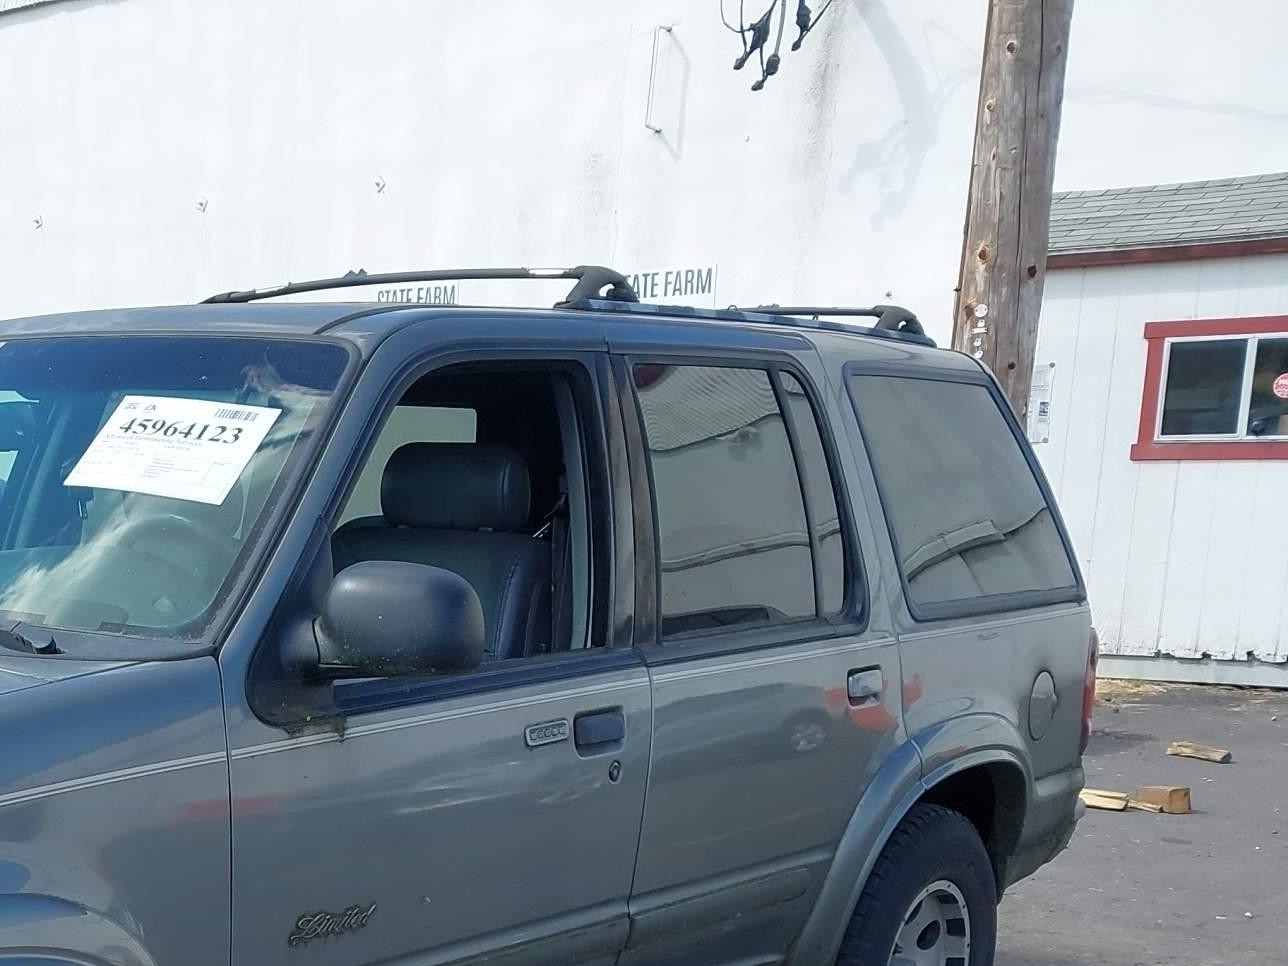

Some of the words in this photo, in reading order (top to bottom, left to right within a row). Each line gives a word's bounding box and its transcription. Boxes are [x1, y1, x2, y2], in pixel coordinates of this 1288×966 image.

[377, 288, 413, 303] STATE
[416, 285, 456, 304] FARM
[663, 267, 713, 297] FARM
[119, 417, 244, 444] 45964123
[290, 903, 377, 943] Limited
